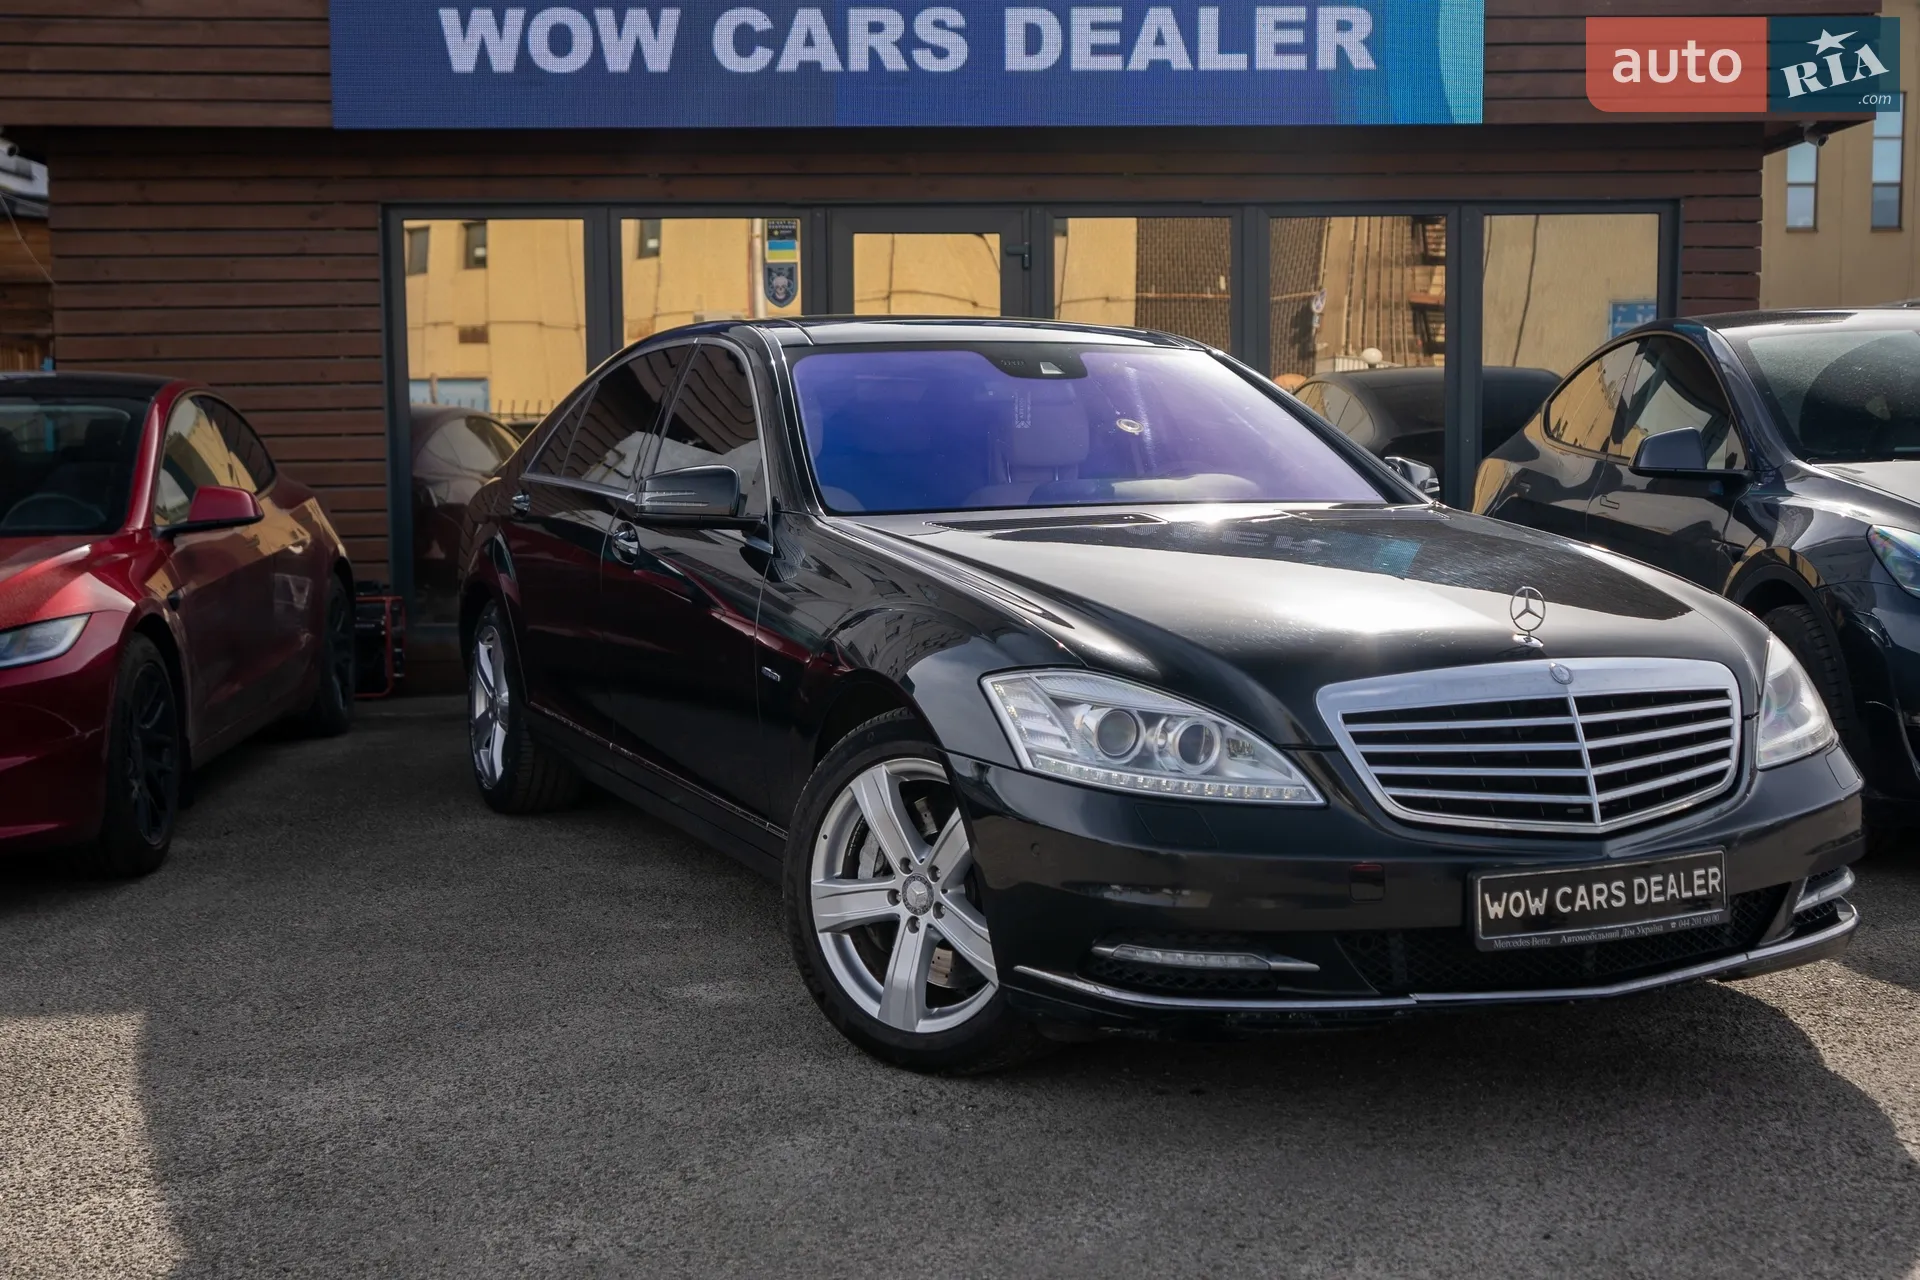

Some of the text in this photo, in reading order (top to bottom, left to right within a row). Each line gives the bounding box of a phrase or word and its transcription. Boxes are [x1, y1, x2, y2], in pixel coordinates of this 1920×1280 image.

[438, 6, 1377, 74] WOW CARS DEALER
[1484, 867, 1722, 920] WOW CARS DEALER
[1560, 924, 1663, 944] Автомобільний Дім Україна
